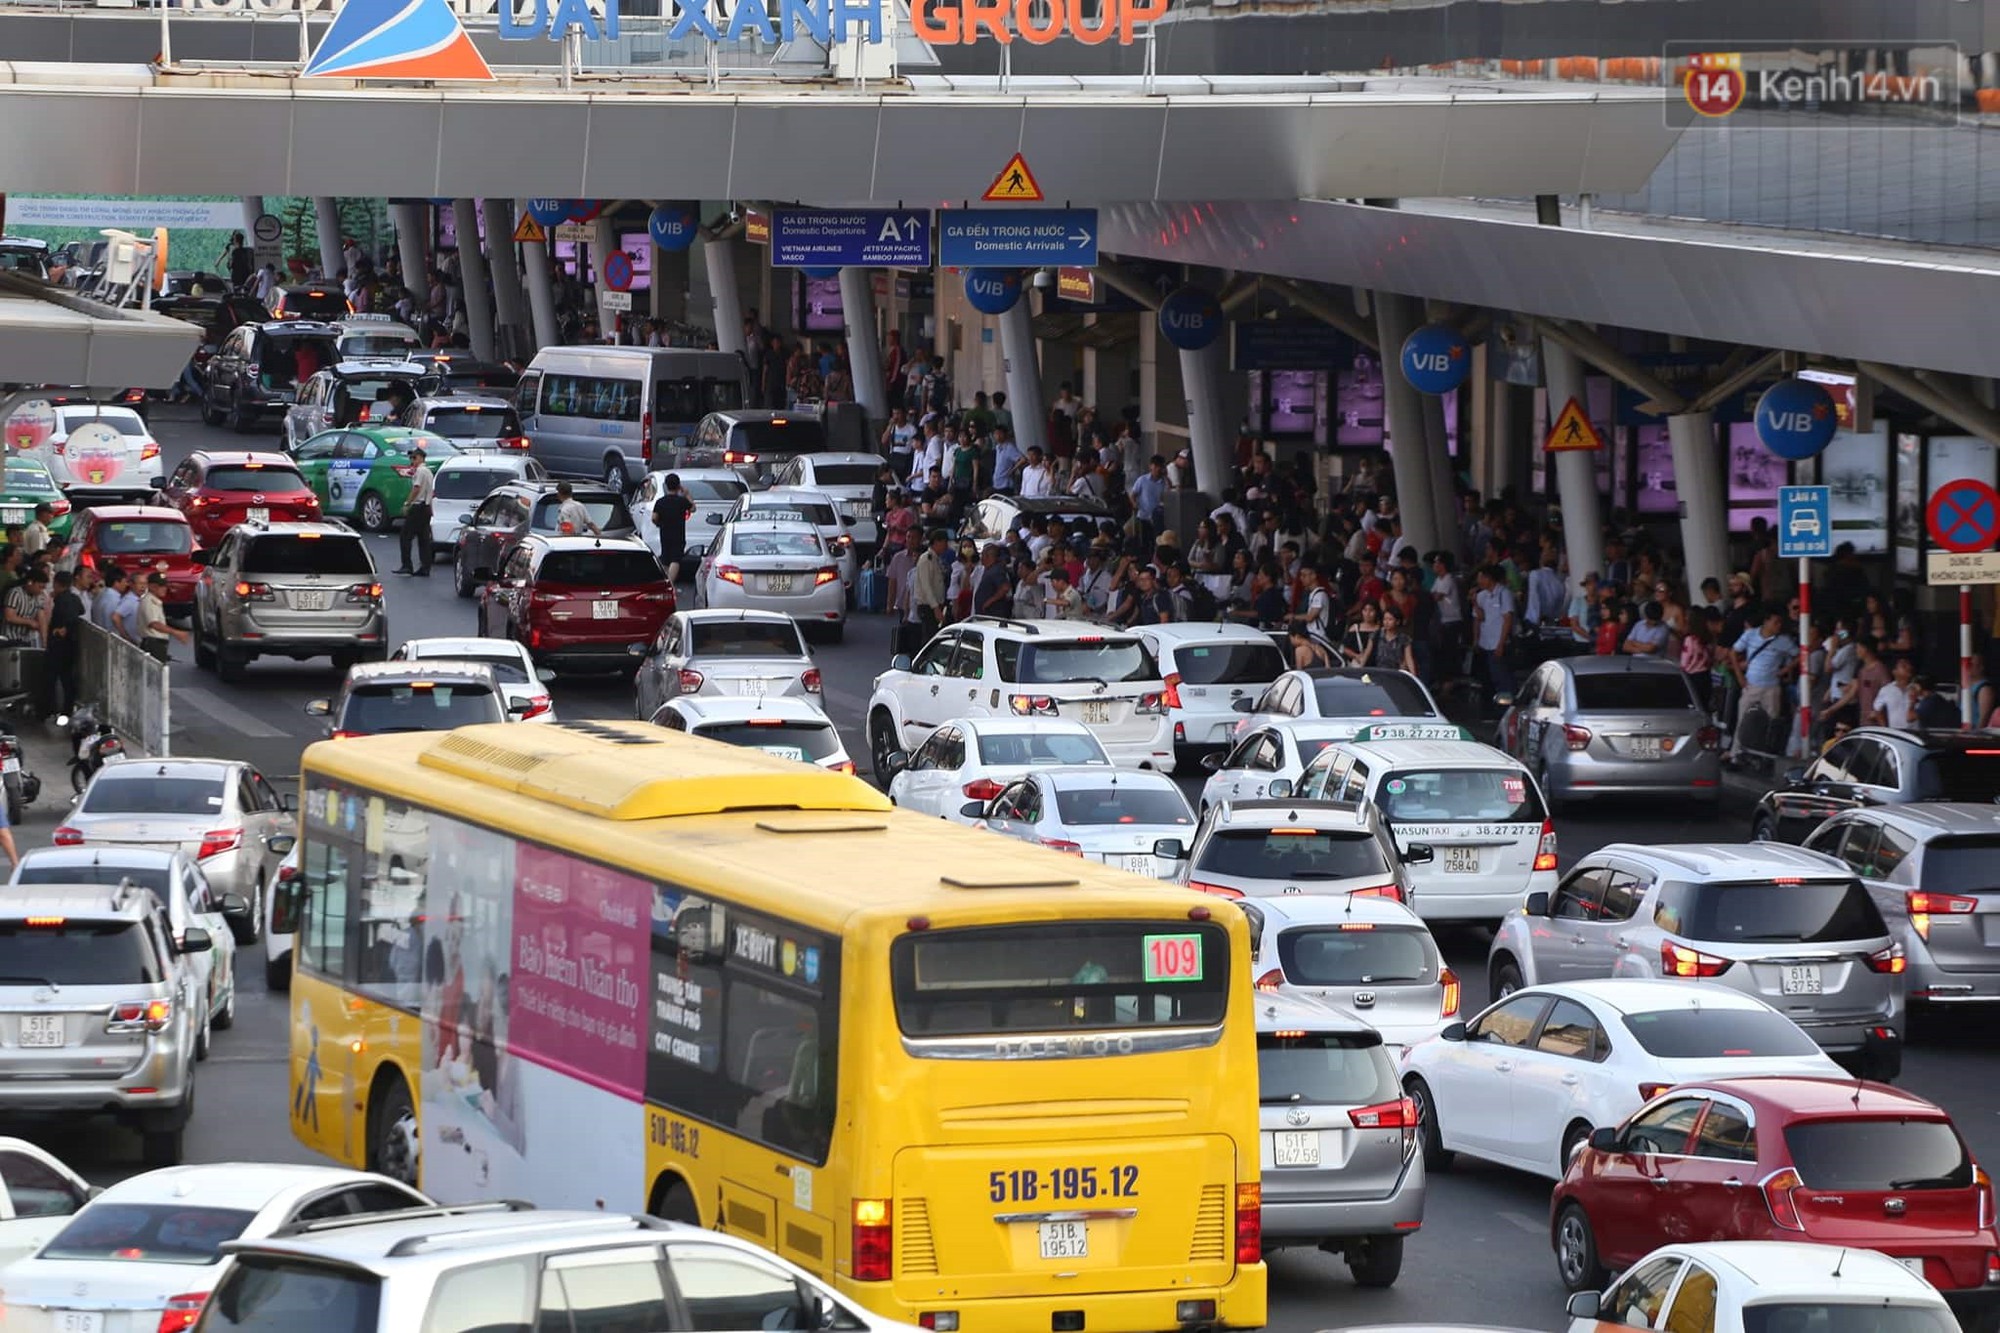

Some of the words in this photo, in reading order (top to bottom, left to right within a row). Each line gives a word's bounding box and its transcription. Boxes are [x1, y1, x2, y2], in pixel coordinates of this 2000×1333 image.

[910, 0, 1168, 45] GROUP
[656, 221, 683, 235] VIB
[782, 216, 796, 225] GA
[808, 216, 839, 225] TRONG
[878, 216, 902, 241] A
[782, 226, 821, 235] Domestic
[821, 226, 867, 237] Departures
[947, 226, 964, 236] GA
[992, 226, 1031, 236] TRONG
[974, 240, 1024, 251] Domestic
[1024, 240, 1065, 251] Arrivals
[972, 278, 1004, 296] VIB
[1169, 309, 1204, 329] VIB
[1412, 352, 1449, 372] VIB
[1768, 409, 1812, 433] VIB
[1426, 729, 1440, 738] 27
[1443, 730, 1457, 738] 27
[1476, 825, 1508, 835] 38.27
[1511, 826, 1525, 835] 27
[1528, 825, 1540, 835] 27
[1151, 938, 1196, 977] 109
[1358, 993, 1374, 1001] KIA
[995, 1037, 1134, 1058] DAEWOO
[1285, 1133, 1308, 1147] 51F
[990, 1165, 1139, 1203] 51B-195.12
[1051, 1223, 1076, 1240] 51B
[1043, 1240, 1086, 1257] 195.12
